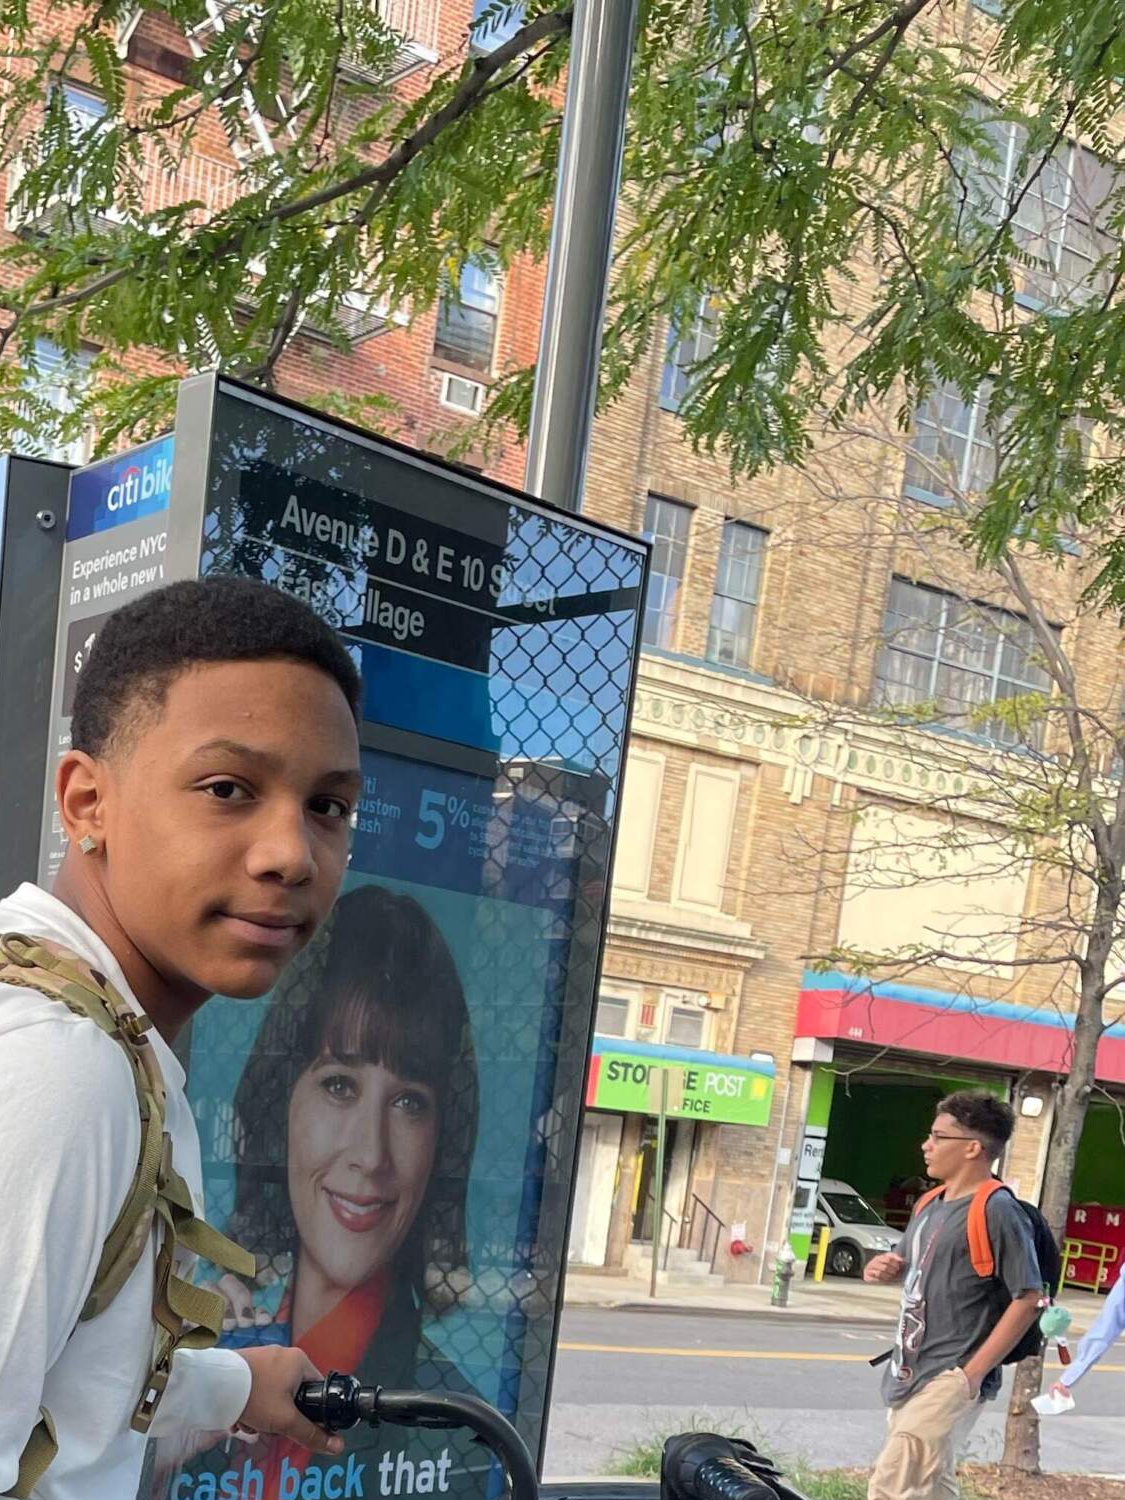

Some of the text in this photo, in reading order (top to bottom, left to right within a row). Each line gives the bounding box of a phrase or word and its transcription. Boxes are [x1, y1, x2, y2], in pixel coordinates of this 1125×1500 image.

[107, 460, 173, 512] citi bik
[72, 546, 137, 580] Experience
[140, 532, 168, 558] NYC
[280, 495, 379, 558] Avenue
[386, 528, 407, 565] D
[412, 539, 429, 576] &
[436, 546, 455, 582] E
[460, 555, 485, 592] 10
[70, 586, 82, 606] in
[83, 586, 91, 602] a
[93, 571, 128, 598] whole
[130, 565, 158, 588] new
[359, 817, 381, 834] ash
[361, 798, 401, 819] ustom
[607, 1061, 746, 1097] STOE POST
[682, 1097, 712, 1113] FICE
[378, 1448, 452, 1496] that
